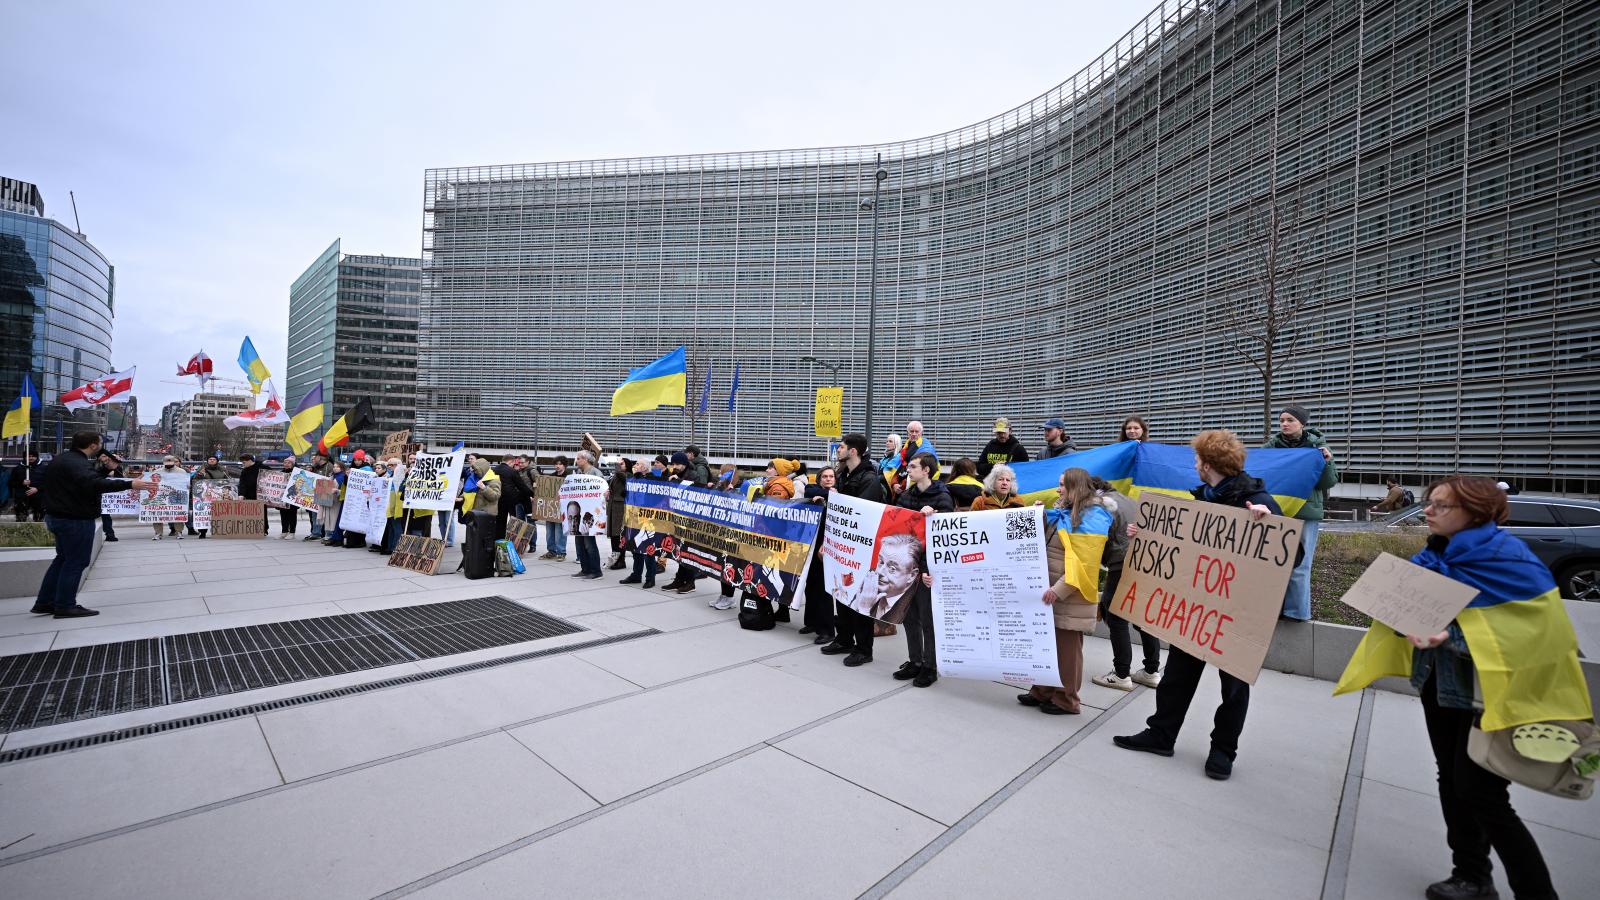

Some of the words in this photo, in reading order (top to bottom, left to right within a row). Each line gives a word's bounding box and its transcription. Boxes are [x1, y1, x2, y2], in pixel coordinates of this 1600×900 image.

[816, 420, 837, 428] UKRAINE
[427, 482, 443, 490] WAY
[412, 490, 446, 500] UKRAINE
[638, 508, 654, 518] STOP
[212, 519, 243, 535] BELGIUM
[841, 518, 848, 527] DE
[850, 520, 858, 529] LA
[931, 516, 968, 532] MAKE
[832, 528, 841, 537] DES
[842, 531, 873, 546] GAUFRES
[932, 531, 989, 548] RUSSIA
[1136, 501, 1189, 541] SHARE
[1191, 510, 1296, 567] UKRAINE'S
[933, 550, 960, 565] PAY
[1128, 537, 1181, 580] RISKS
[1192, 554, 1236, 600] FOR
[1119, 581, 1137, 614] A
[1144, 587, 1234, 655] CHANGE
